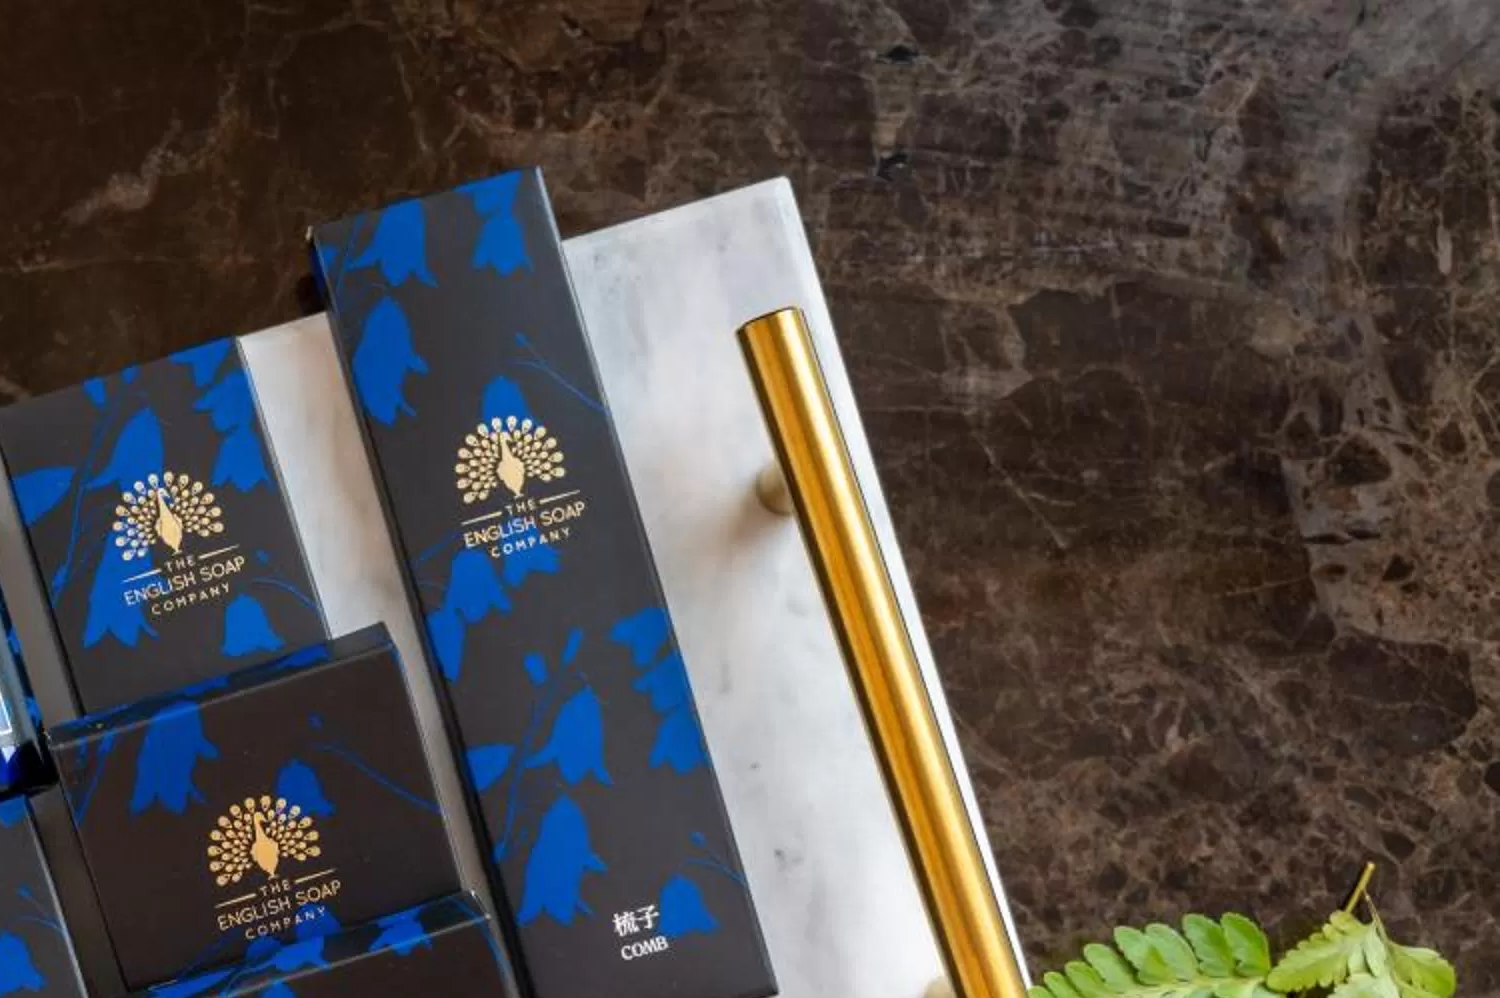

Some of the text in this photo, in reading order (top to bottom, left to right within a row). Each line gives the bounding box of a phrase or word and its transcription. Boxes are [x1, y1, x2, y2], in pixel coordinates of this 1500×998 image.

[505, 499, 536, 515] THE
[463, 501, 585, 548] ENGLISH SOAP
[491, 527, 570, 558] COMPANY
[164, 555, 196, 573] THE
[123, 556, 245, 606] ENGLISH SOAP
[151, 583, 229, 615] COMPANY
[259, 879, 291, 896] THE
[217, 879, 341, 931] ENGLISH SOAP
[612, 904, 659, 937] 梳子
[245, 906, 325, 940] COMPANY
[621, 935, 668, 960] COMB
